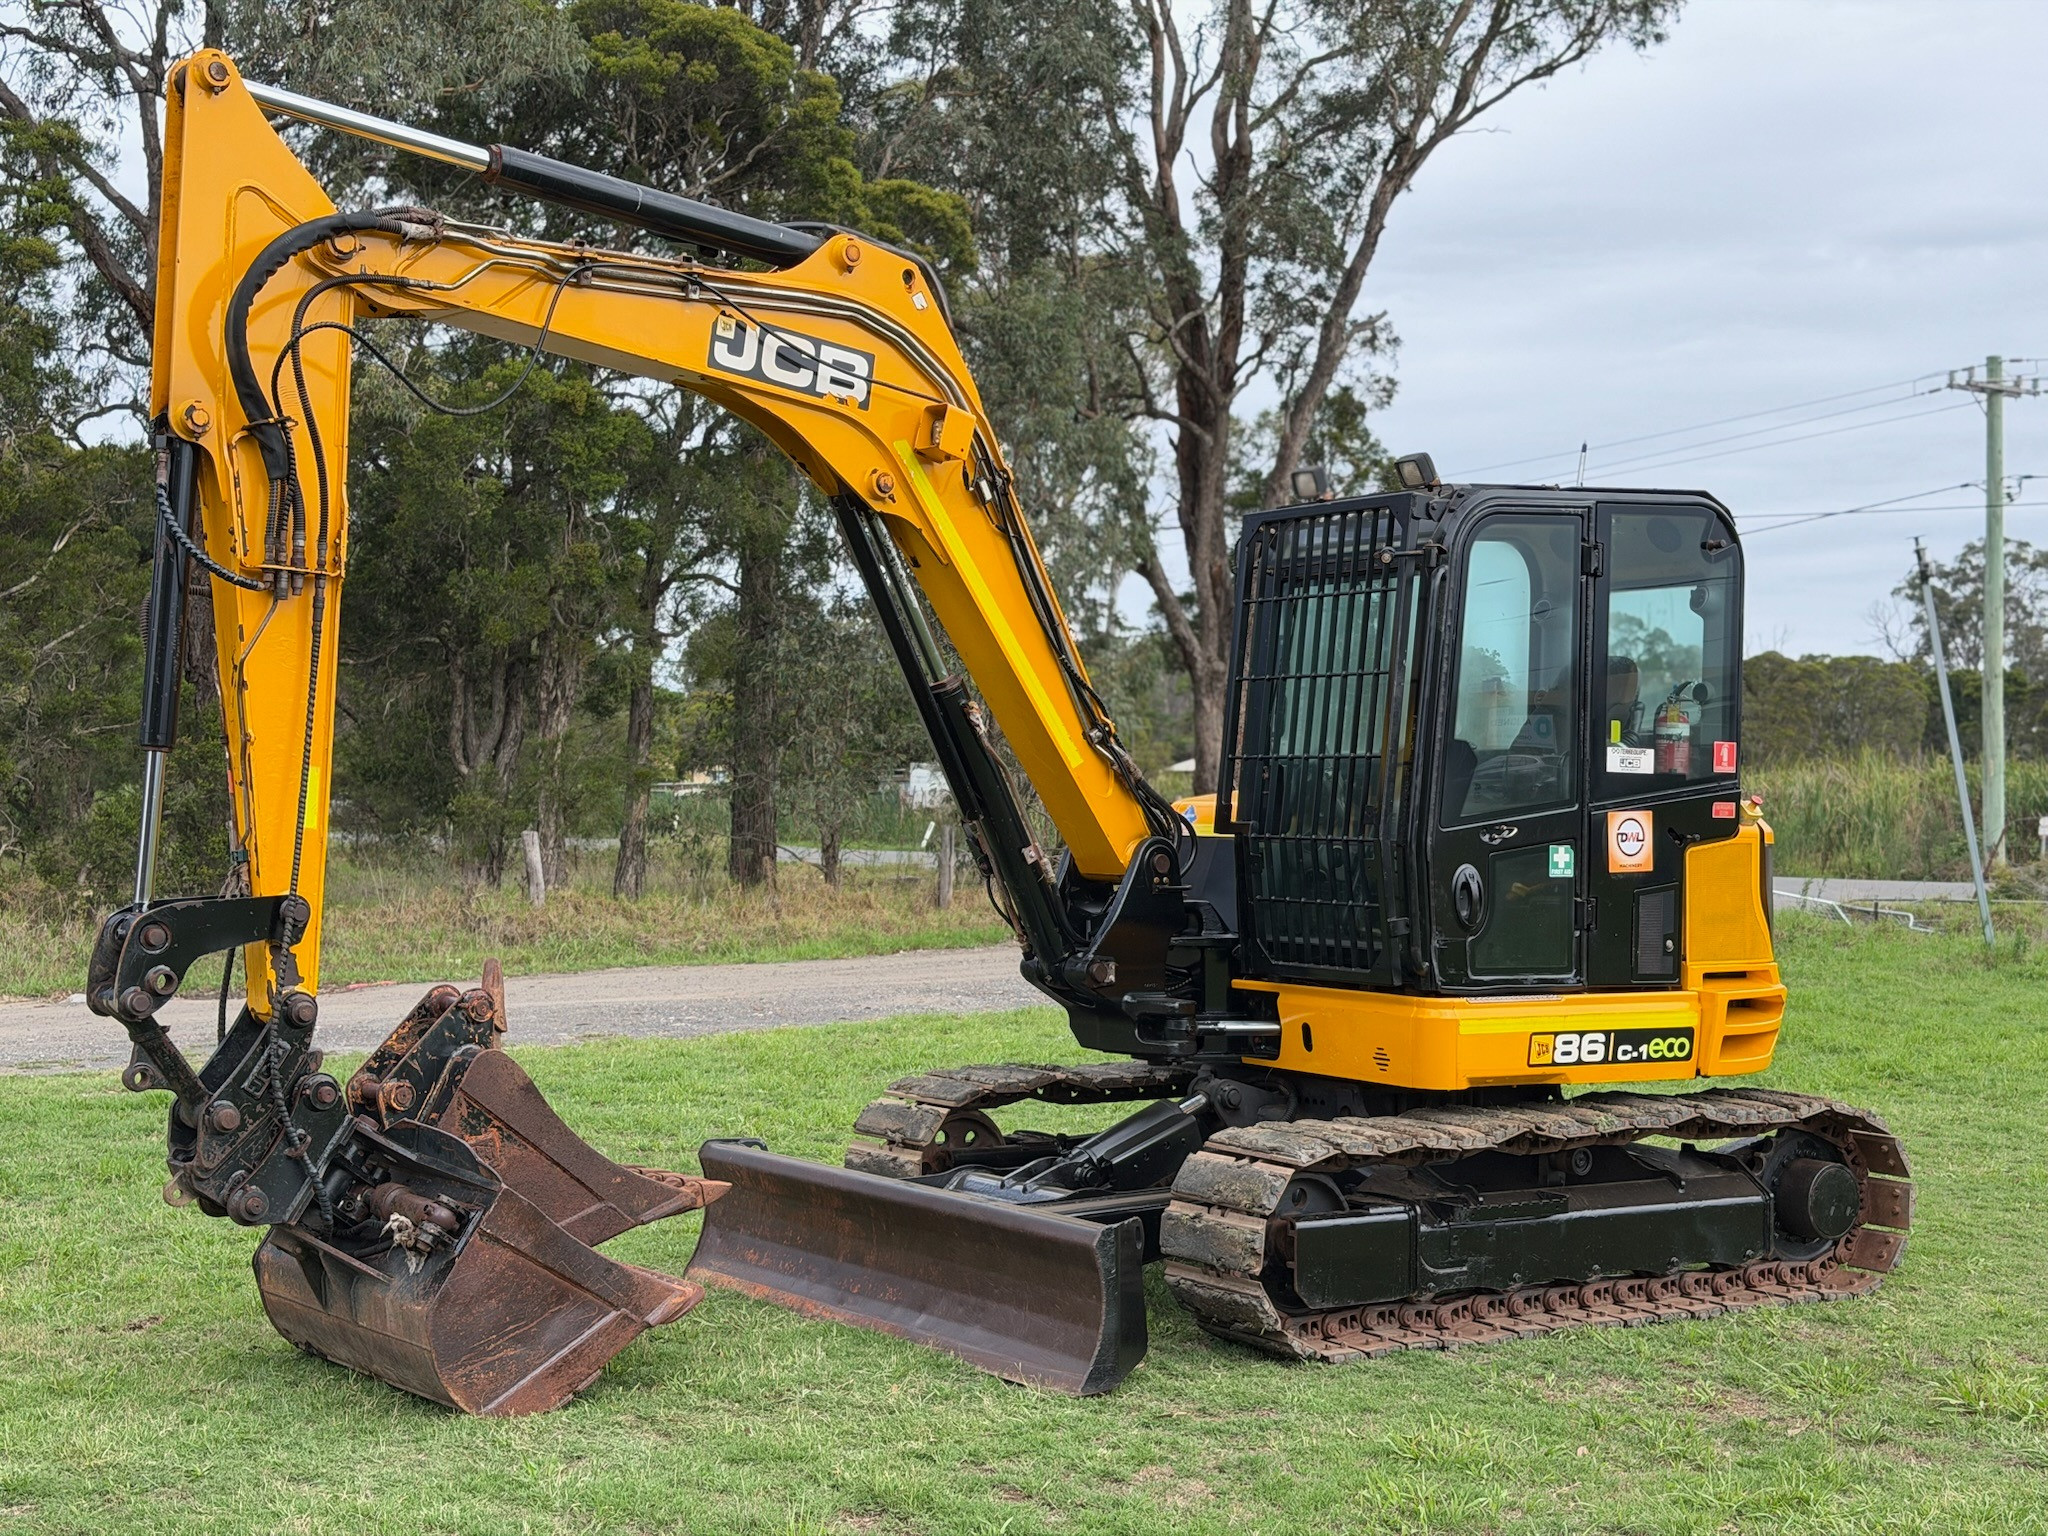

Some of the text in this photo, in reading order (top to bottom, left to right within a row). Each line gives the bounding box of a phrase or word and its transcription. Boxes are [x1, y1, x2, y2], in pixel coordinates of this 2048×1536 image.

[713, 324, 869, 404] JCB
[1620, 759, 1640, 768] JCB
[1553, 1032, 1606, 1063] 86
